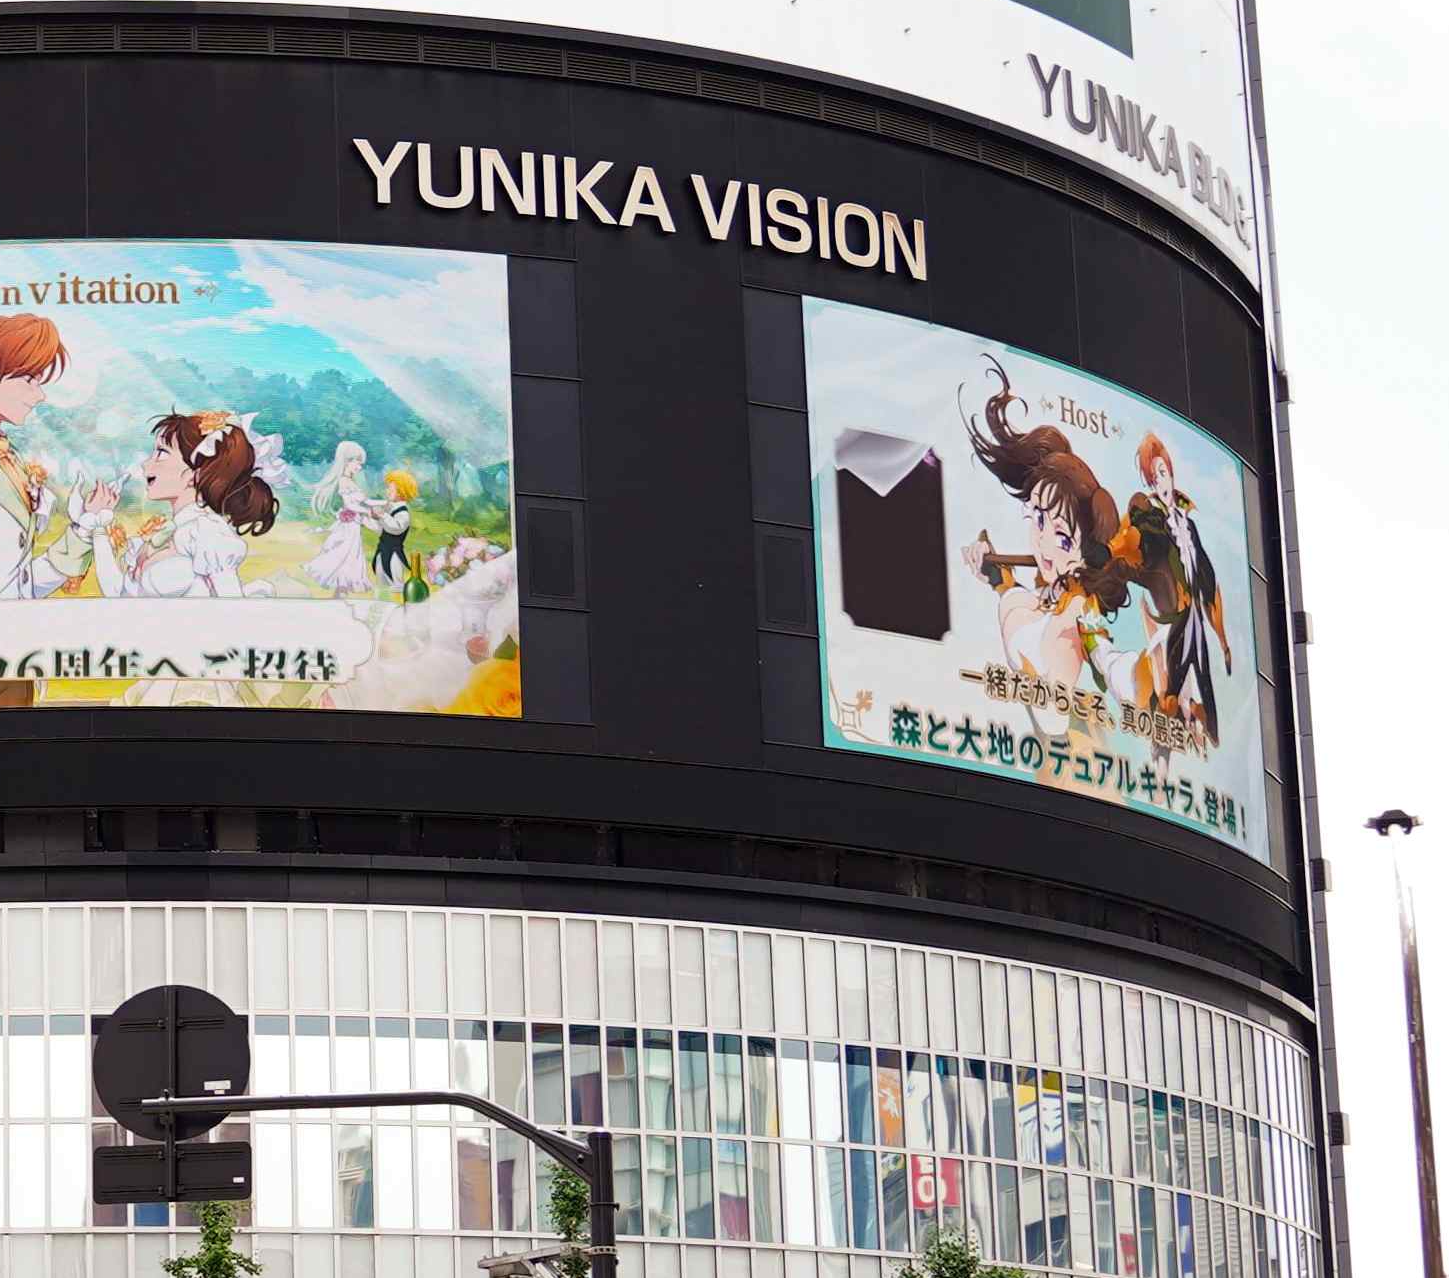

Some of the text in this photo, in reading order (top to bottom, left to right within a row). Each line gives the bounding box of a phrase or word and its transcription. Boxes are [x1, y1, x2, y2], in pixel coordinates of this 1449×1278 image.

[1025, 53, 1183, 180] YUNIKA
[353, 136, 927, 284] YUNIKA VISION
[1058, 395, 1110, 439] Host
